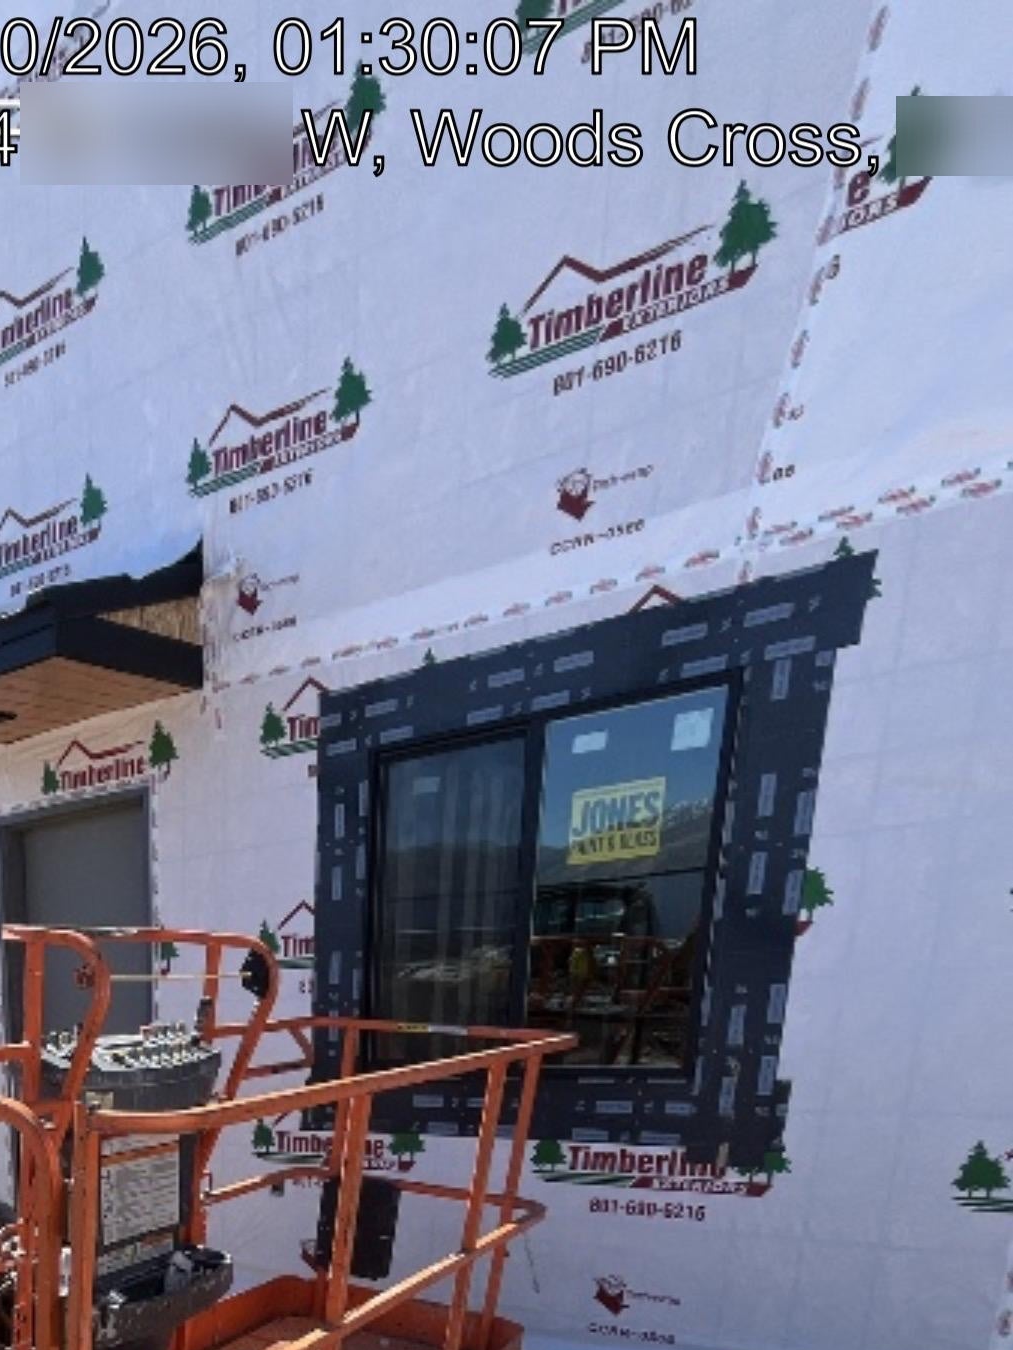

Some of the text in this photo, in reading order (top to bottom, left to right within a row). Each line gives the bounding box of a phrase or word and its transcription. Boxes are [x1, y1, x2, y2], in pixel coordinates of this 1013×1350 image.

[528, 252, 709, 352] Timberline
[213, 409, 329, 477] Timberline
[60, 756, 145, 792] Timberline
[571, 790, 661, 837] JONES
